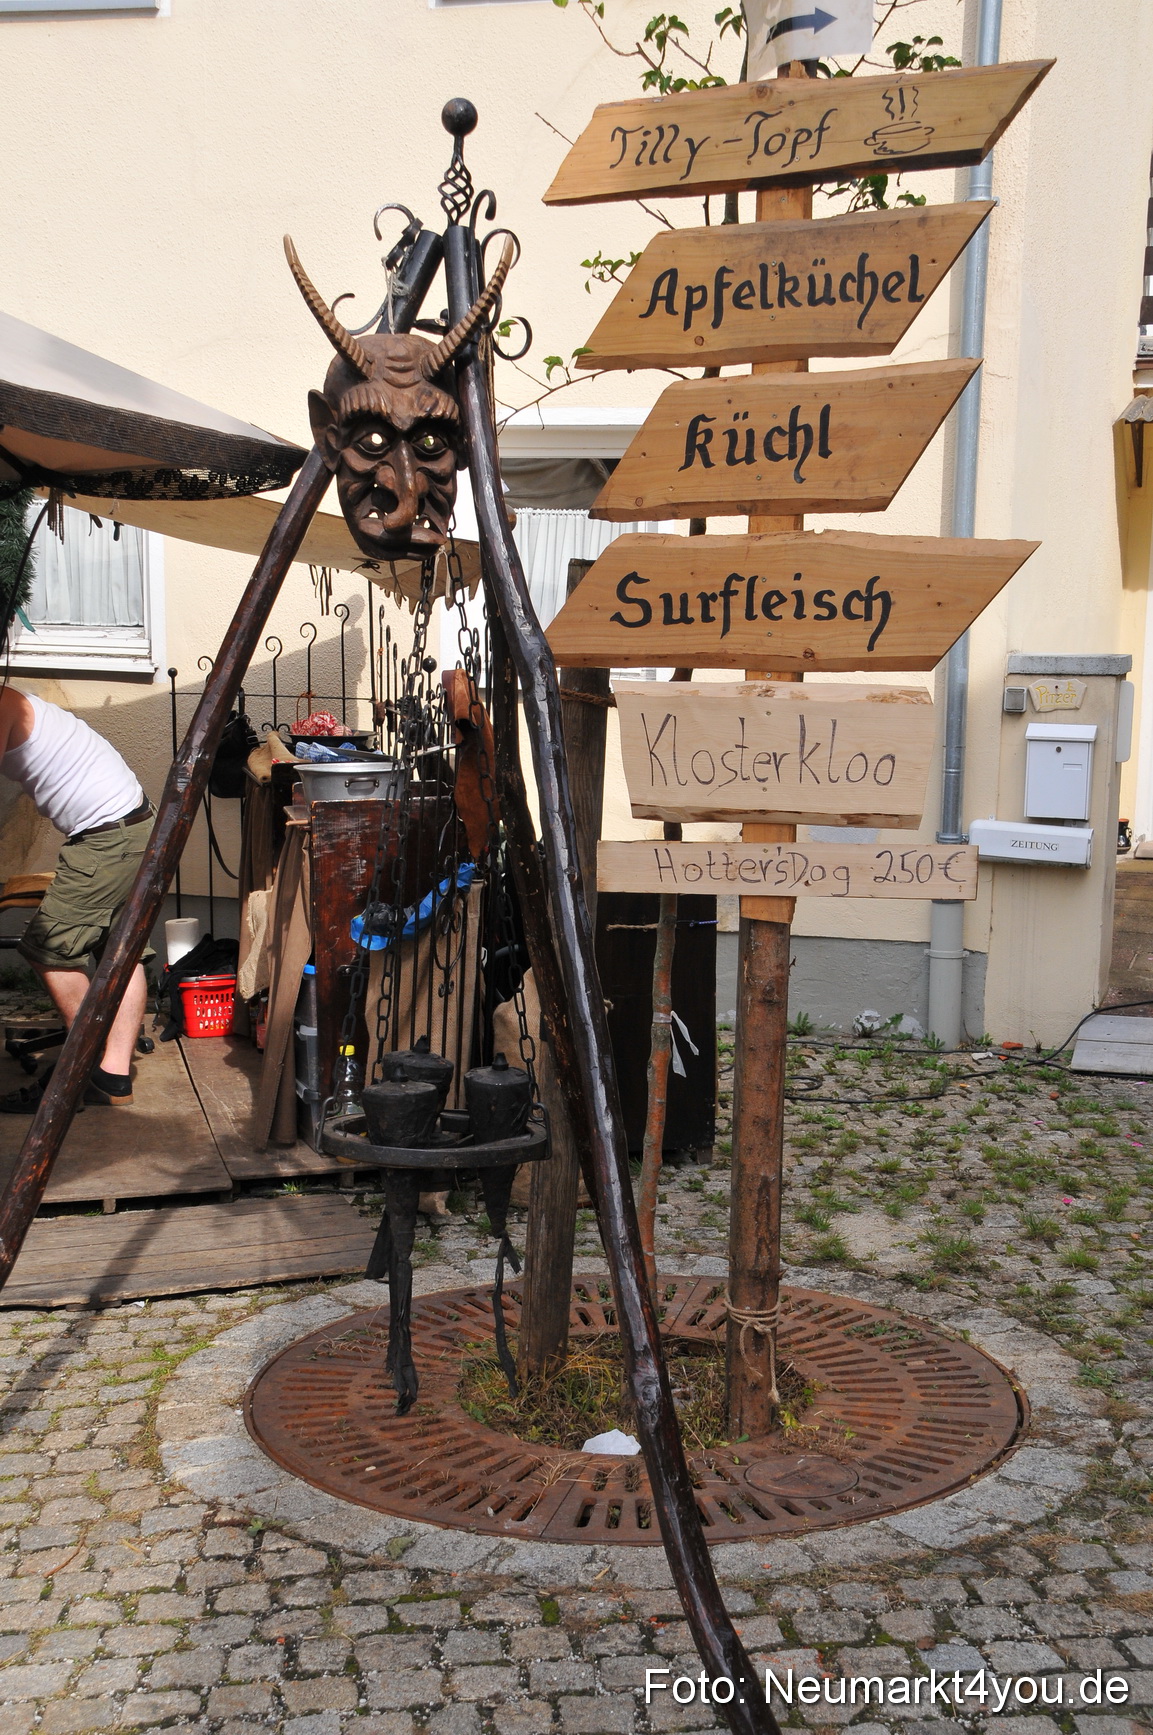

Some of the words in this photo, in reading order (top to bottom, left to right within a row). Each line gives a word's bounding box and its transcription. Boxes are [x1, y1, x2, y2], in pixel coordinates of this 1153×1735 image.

[638, 252, 926, 331] Apfelküchel
[609, 571, 893, 652] Surfleisch
[1011, 839, 1058, 851] ZEITUNG
